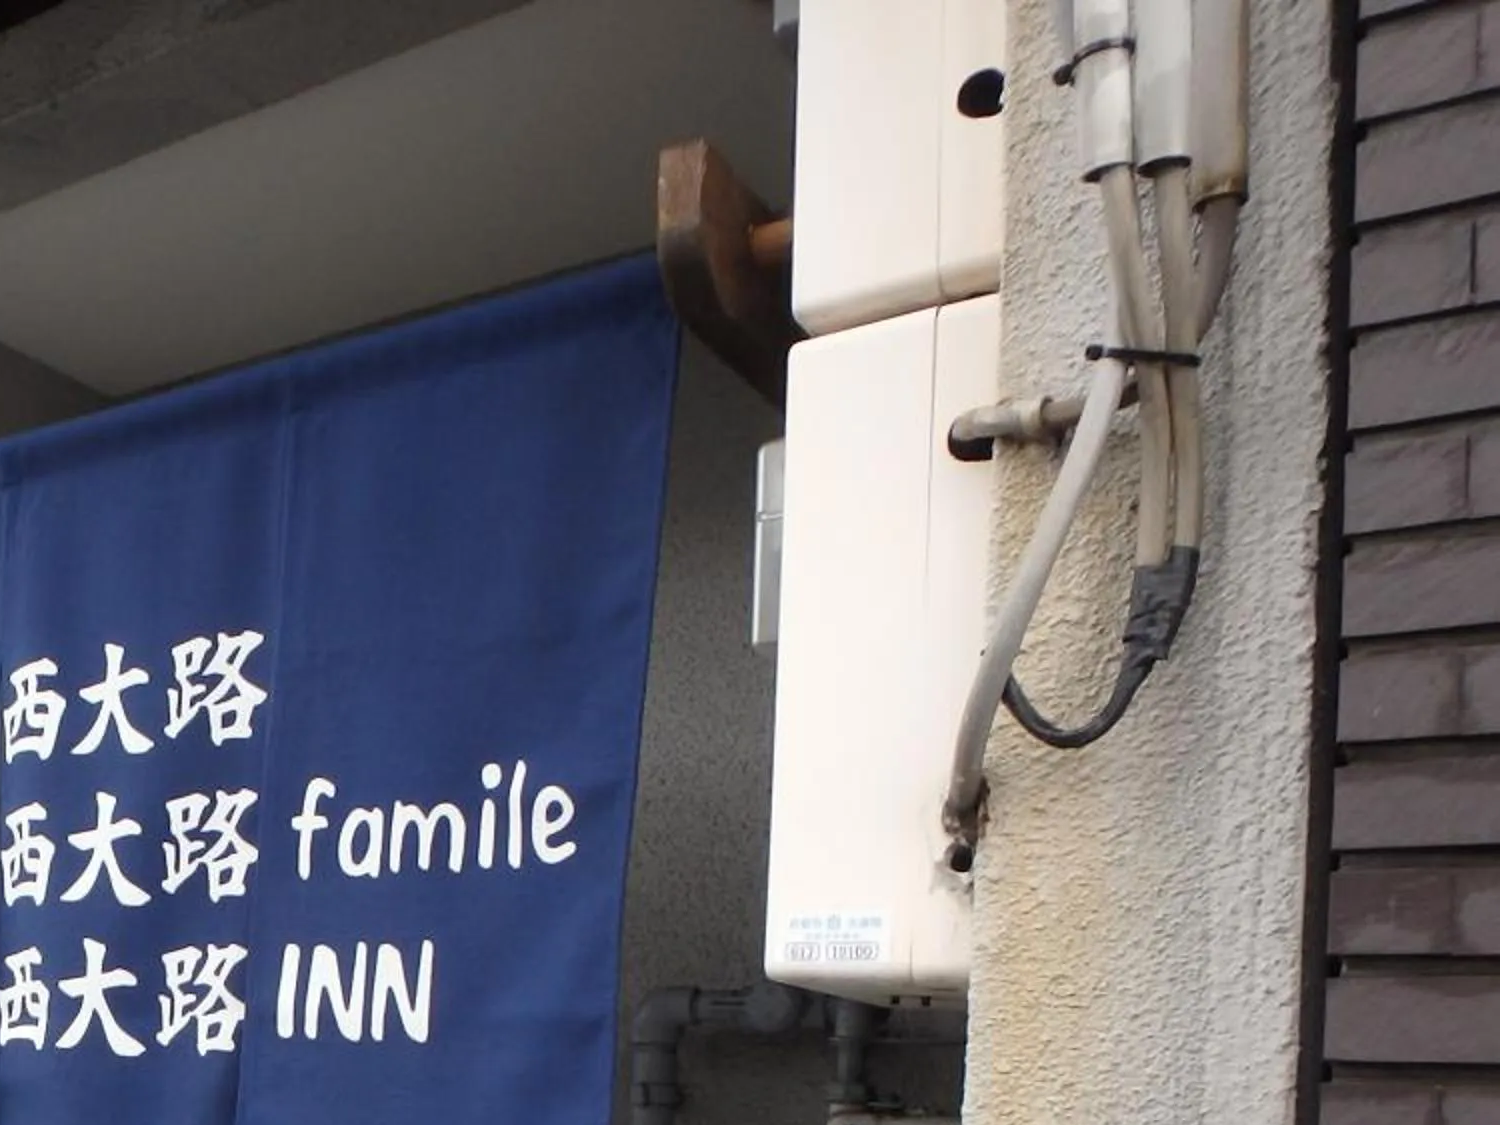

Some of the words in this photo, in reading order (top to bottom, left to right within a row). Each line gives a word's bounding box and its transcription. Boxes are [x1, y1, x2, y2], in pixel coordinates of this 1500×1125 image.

[2, 630, 268, 764] 西大路
[0, 788, 259, 908] 西大路
[291, 760, 577, 881] famile
[277, 939, 435, 1044] INN
